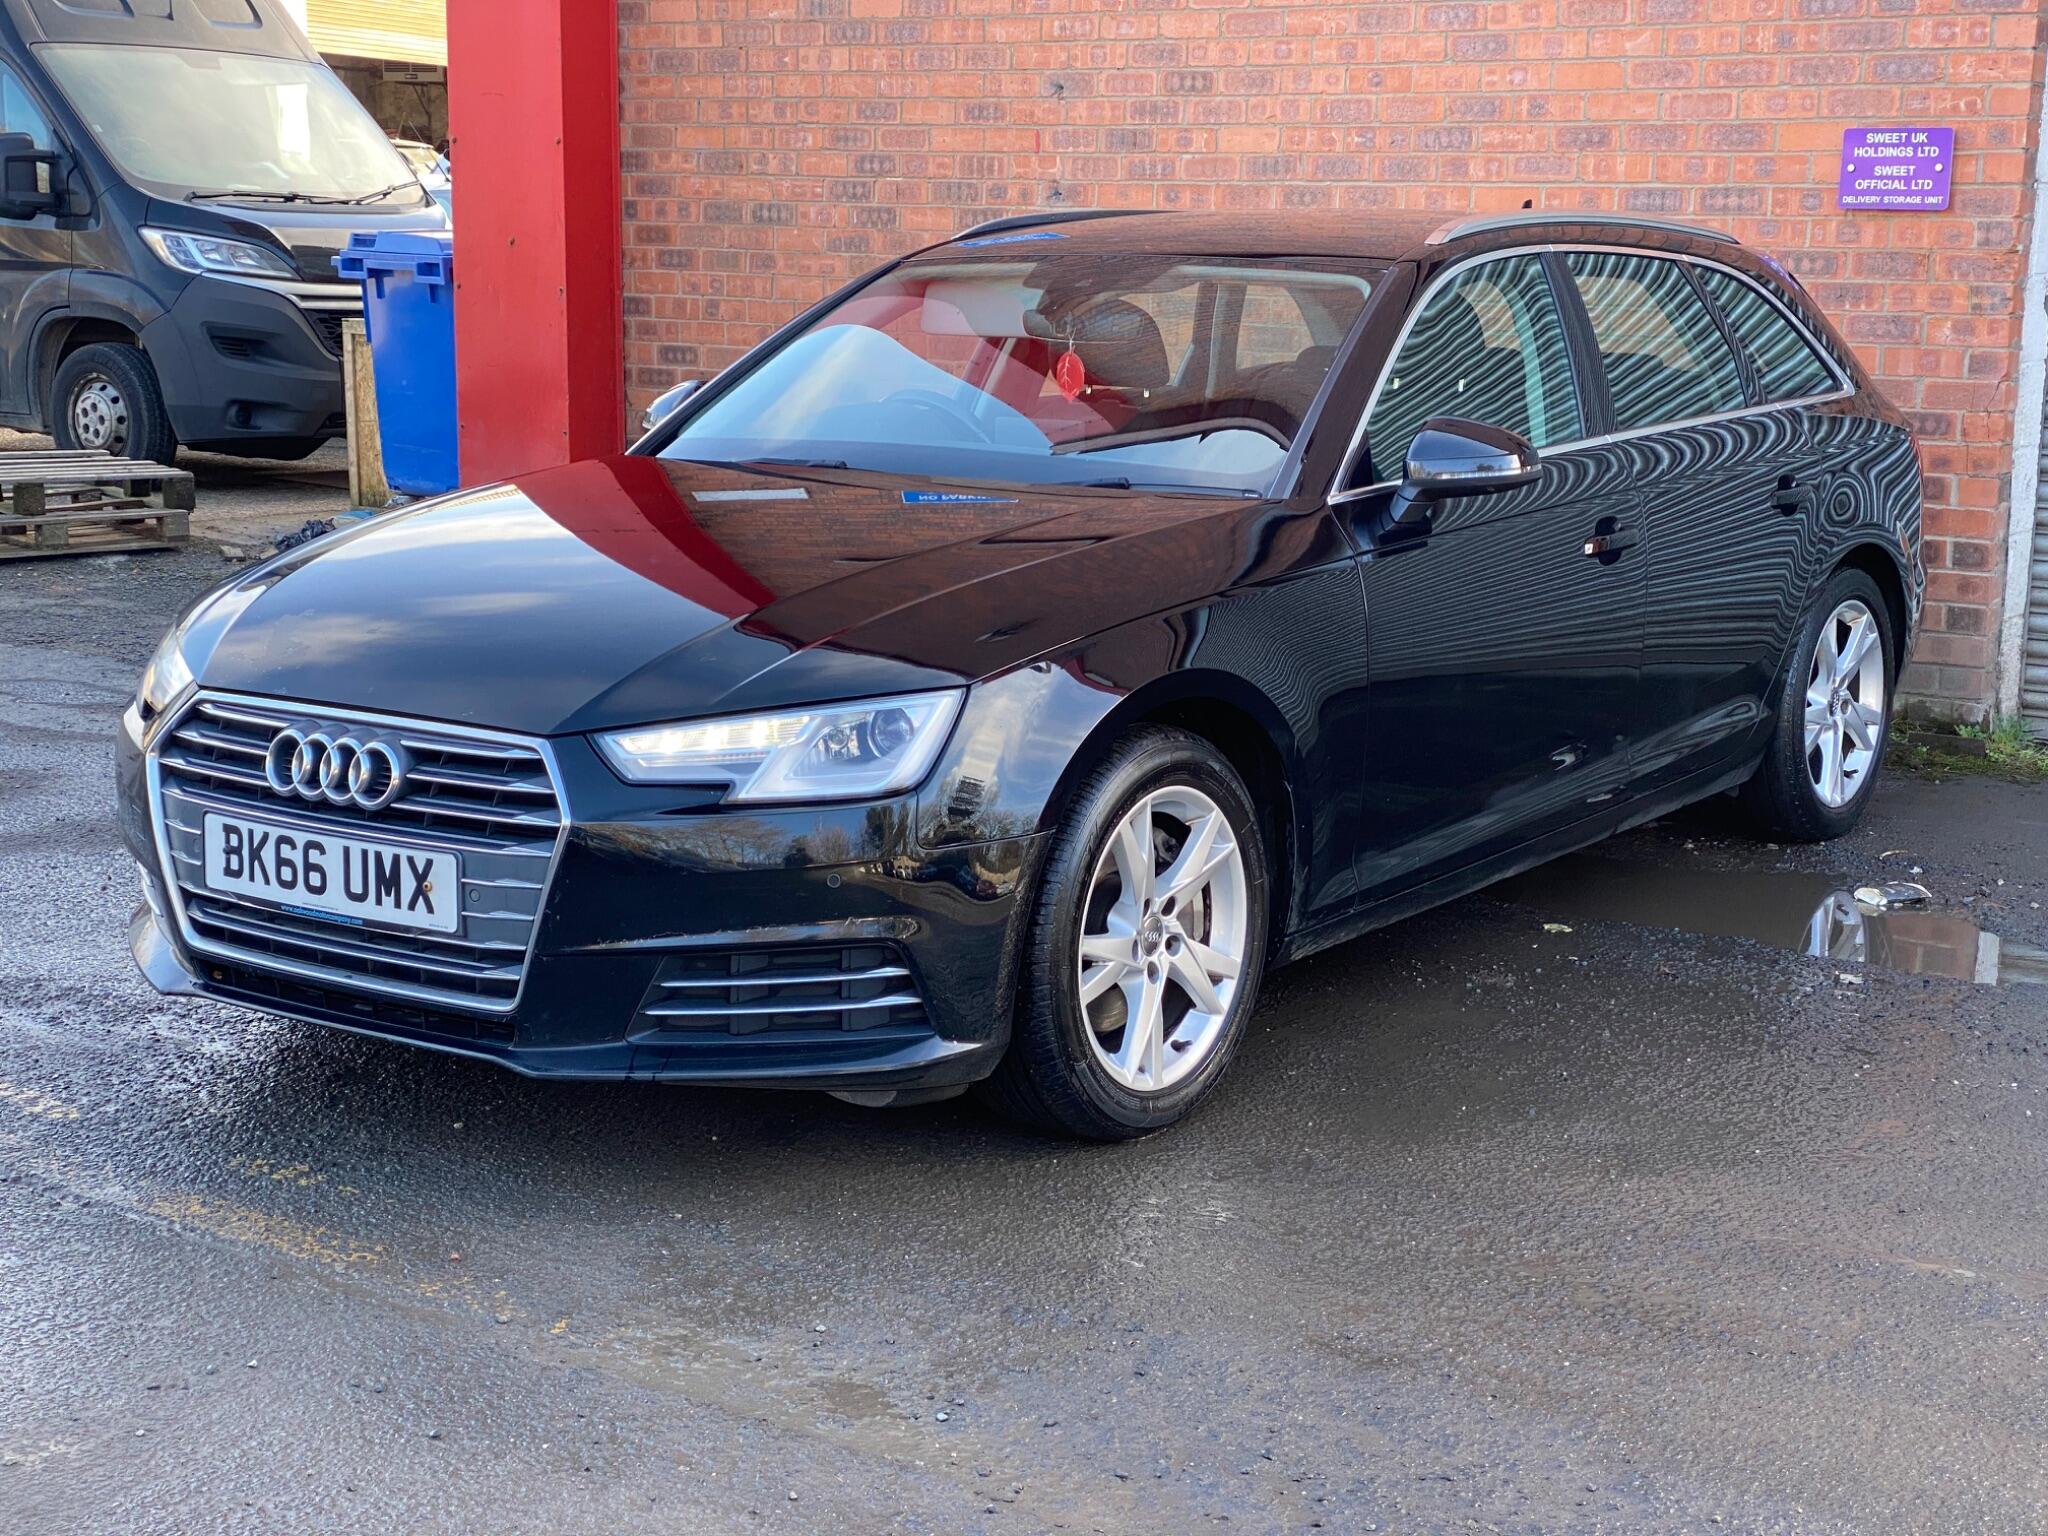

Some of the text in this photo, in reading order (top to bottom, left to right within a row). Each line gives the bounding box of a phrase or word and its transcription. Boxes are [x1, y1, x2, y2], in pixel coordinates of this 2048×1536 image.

[1866, 132, 1928, 143] SWEET UK
[1854, 147, 1939, 157] HOLDINGS LTD
[1874, 166, 1916, 176] SWEET
[1855, 180, 1933, 190] OFFICIAL LTD
[1842, 195, 1944, 204] DELIVERY STORAGE UNIT
[222, 823, 435, 915] BK66 UMX
